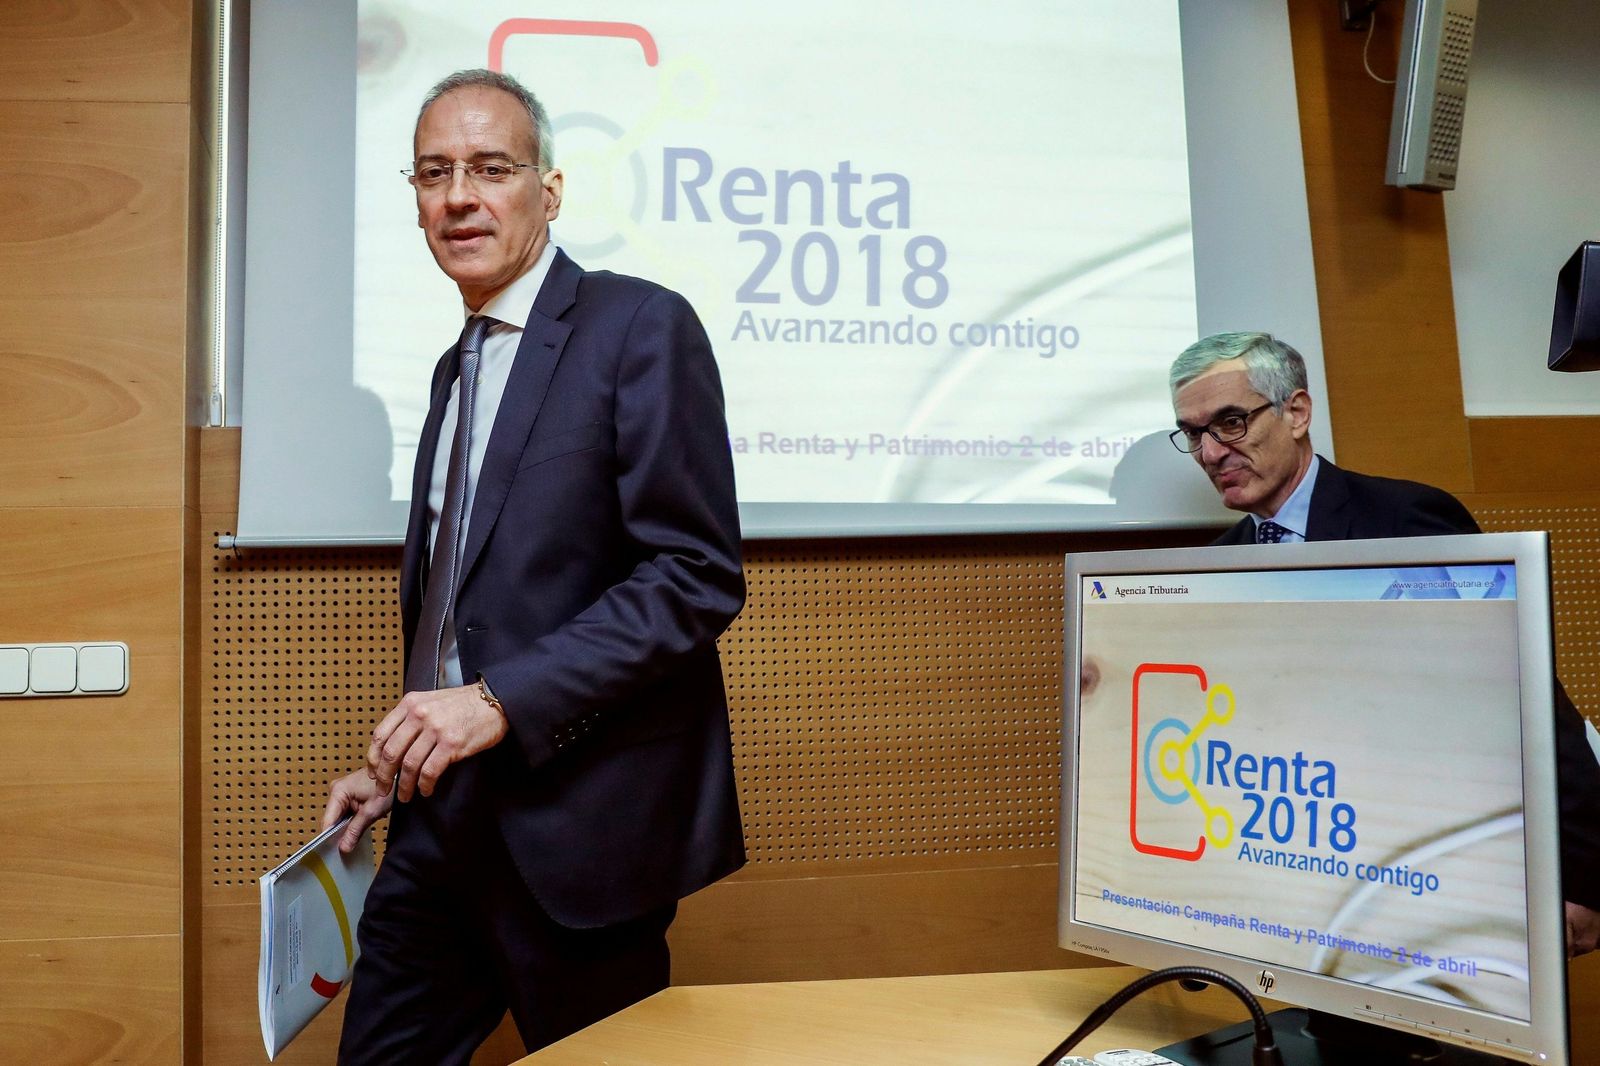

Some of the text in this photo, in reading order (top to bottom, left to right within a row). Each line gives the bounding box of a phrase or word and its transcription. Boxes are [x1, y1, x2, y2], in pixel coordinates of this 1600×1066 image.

[661, 147, 911, 229] Renta
[735, 230, 949, 309] 2018
[731, 310, 1080, 358] Avanzando contigo
[758, 432, 835, 455] Renta
[845, 437, 860, 460] y
[869, 433, 1010, 457] Patrimonio
[1019, 435, 1034, 457] 2
[1042, 435, 1073, 457] de
[1115, 585, 1189, 598] Agencia Tributaria
[1392, 579, 1495, 590] www.agenciatributaria.es
[1206, 740, 1336, 798] Renta
[1240, 792, 1357, 853] 2018
[1238, 842, 1439, 896] Avanzando contigo
[1102, 889, 1477, 977] Presentación Campaña Renta y Patrimonio 2 de abril
[1259, 969, 1274, 993] hp
